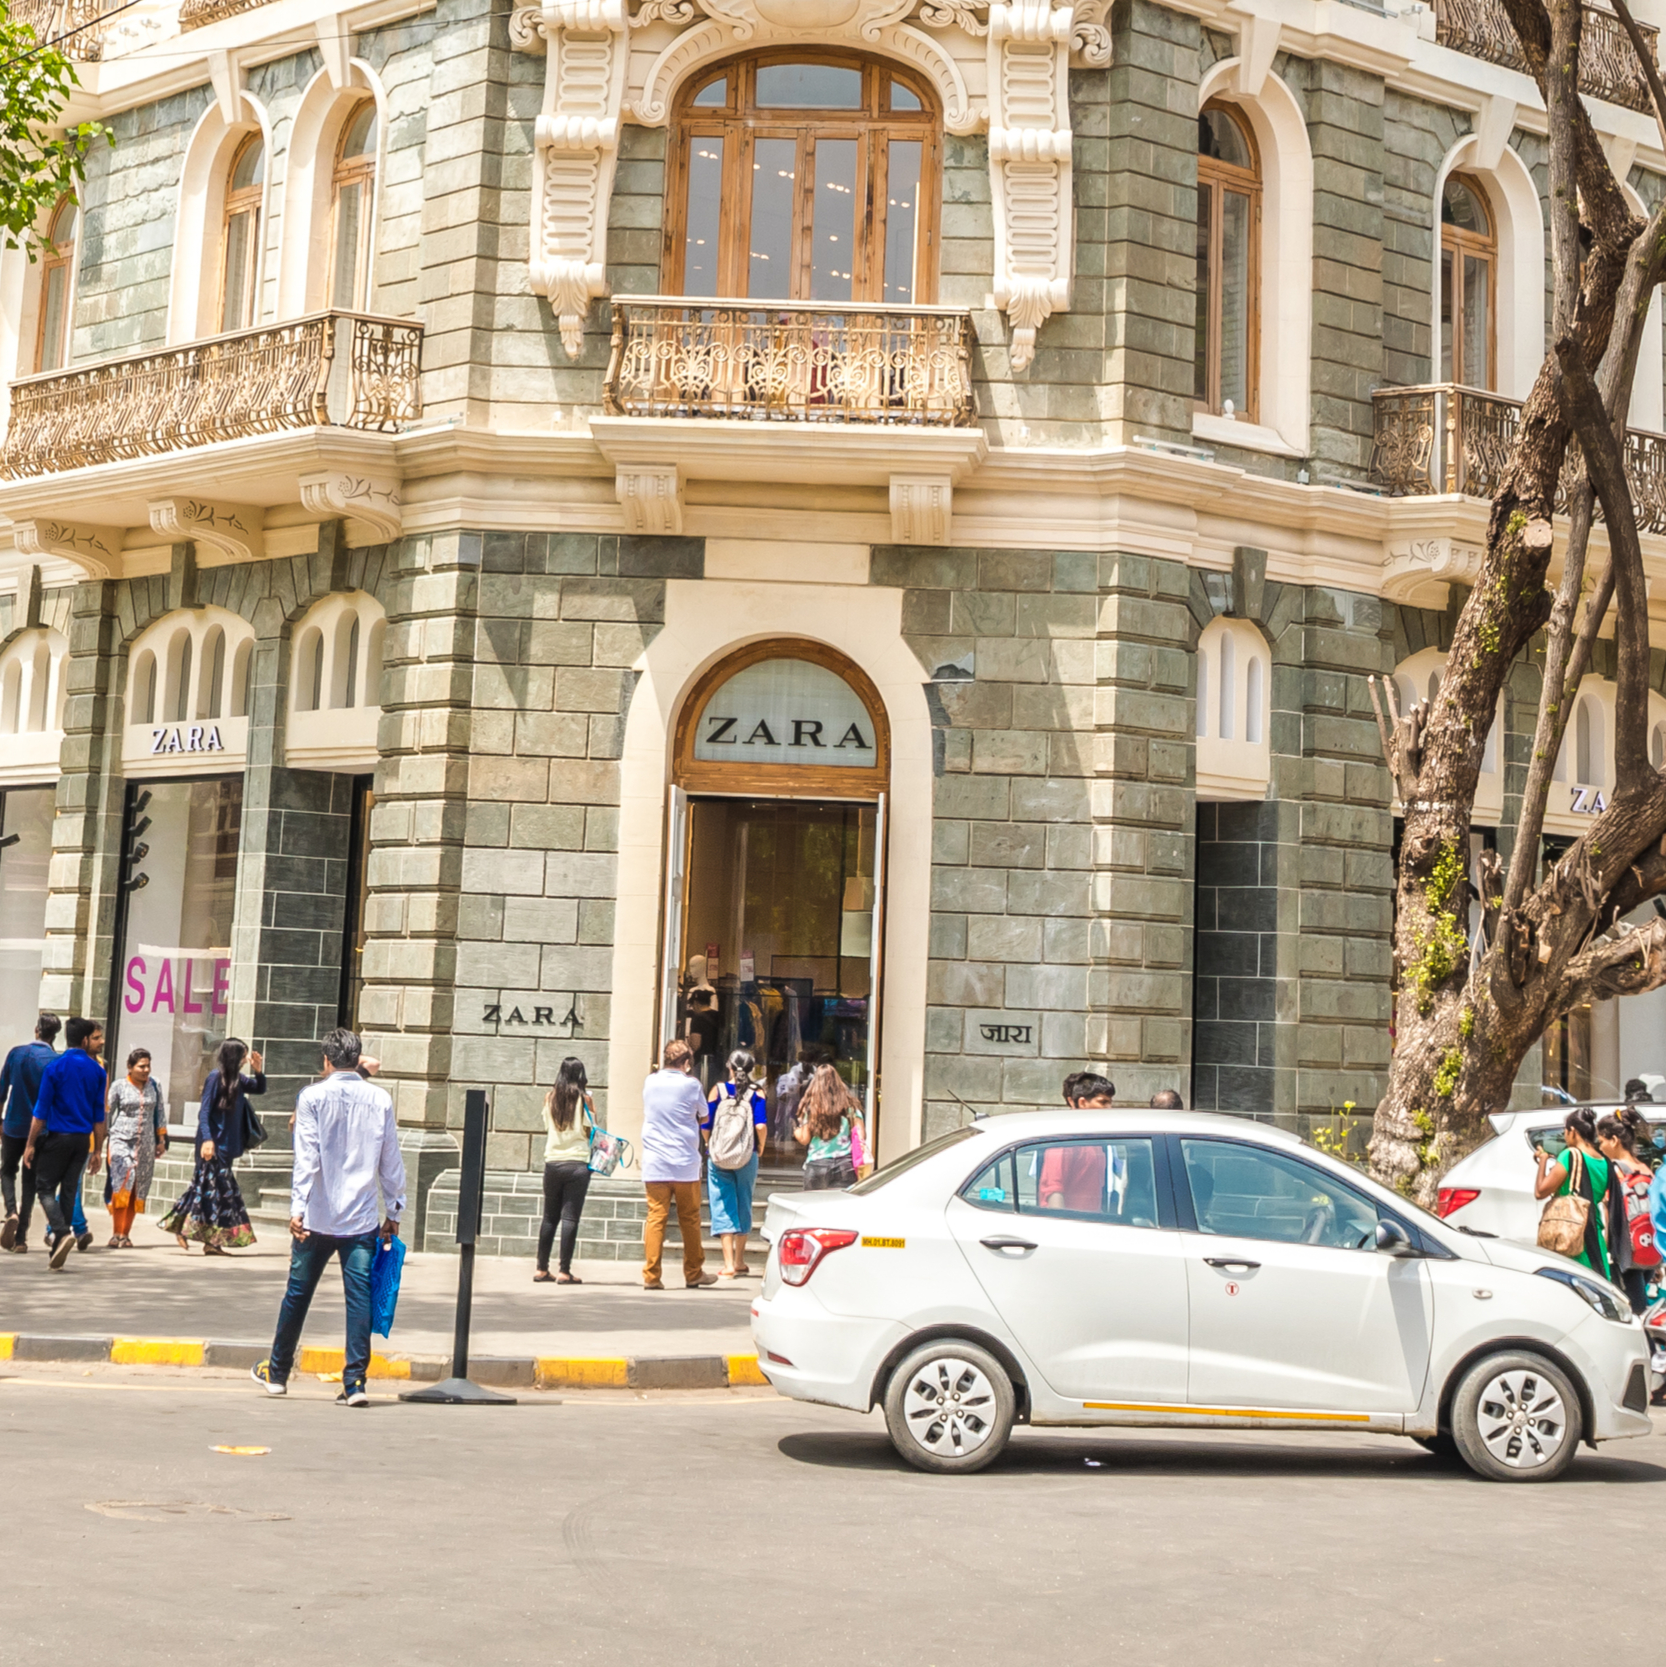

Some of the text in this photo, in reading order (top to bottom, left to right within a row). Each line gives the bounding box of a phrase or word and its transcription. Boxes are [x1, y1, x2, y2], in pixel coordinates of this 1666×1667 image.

[150, 726, 224, 753] ZARA
[706, 716, 873, 749] ZARA
[1570, 787, 1608, 814] ZA
[124, 956, 231, 1015] SALE
[482, 1004, 584, 1026] ZARA
[979, 1024, 1032, 1043] जारा
